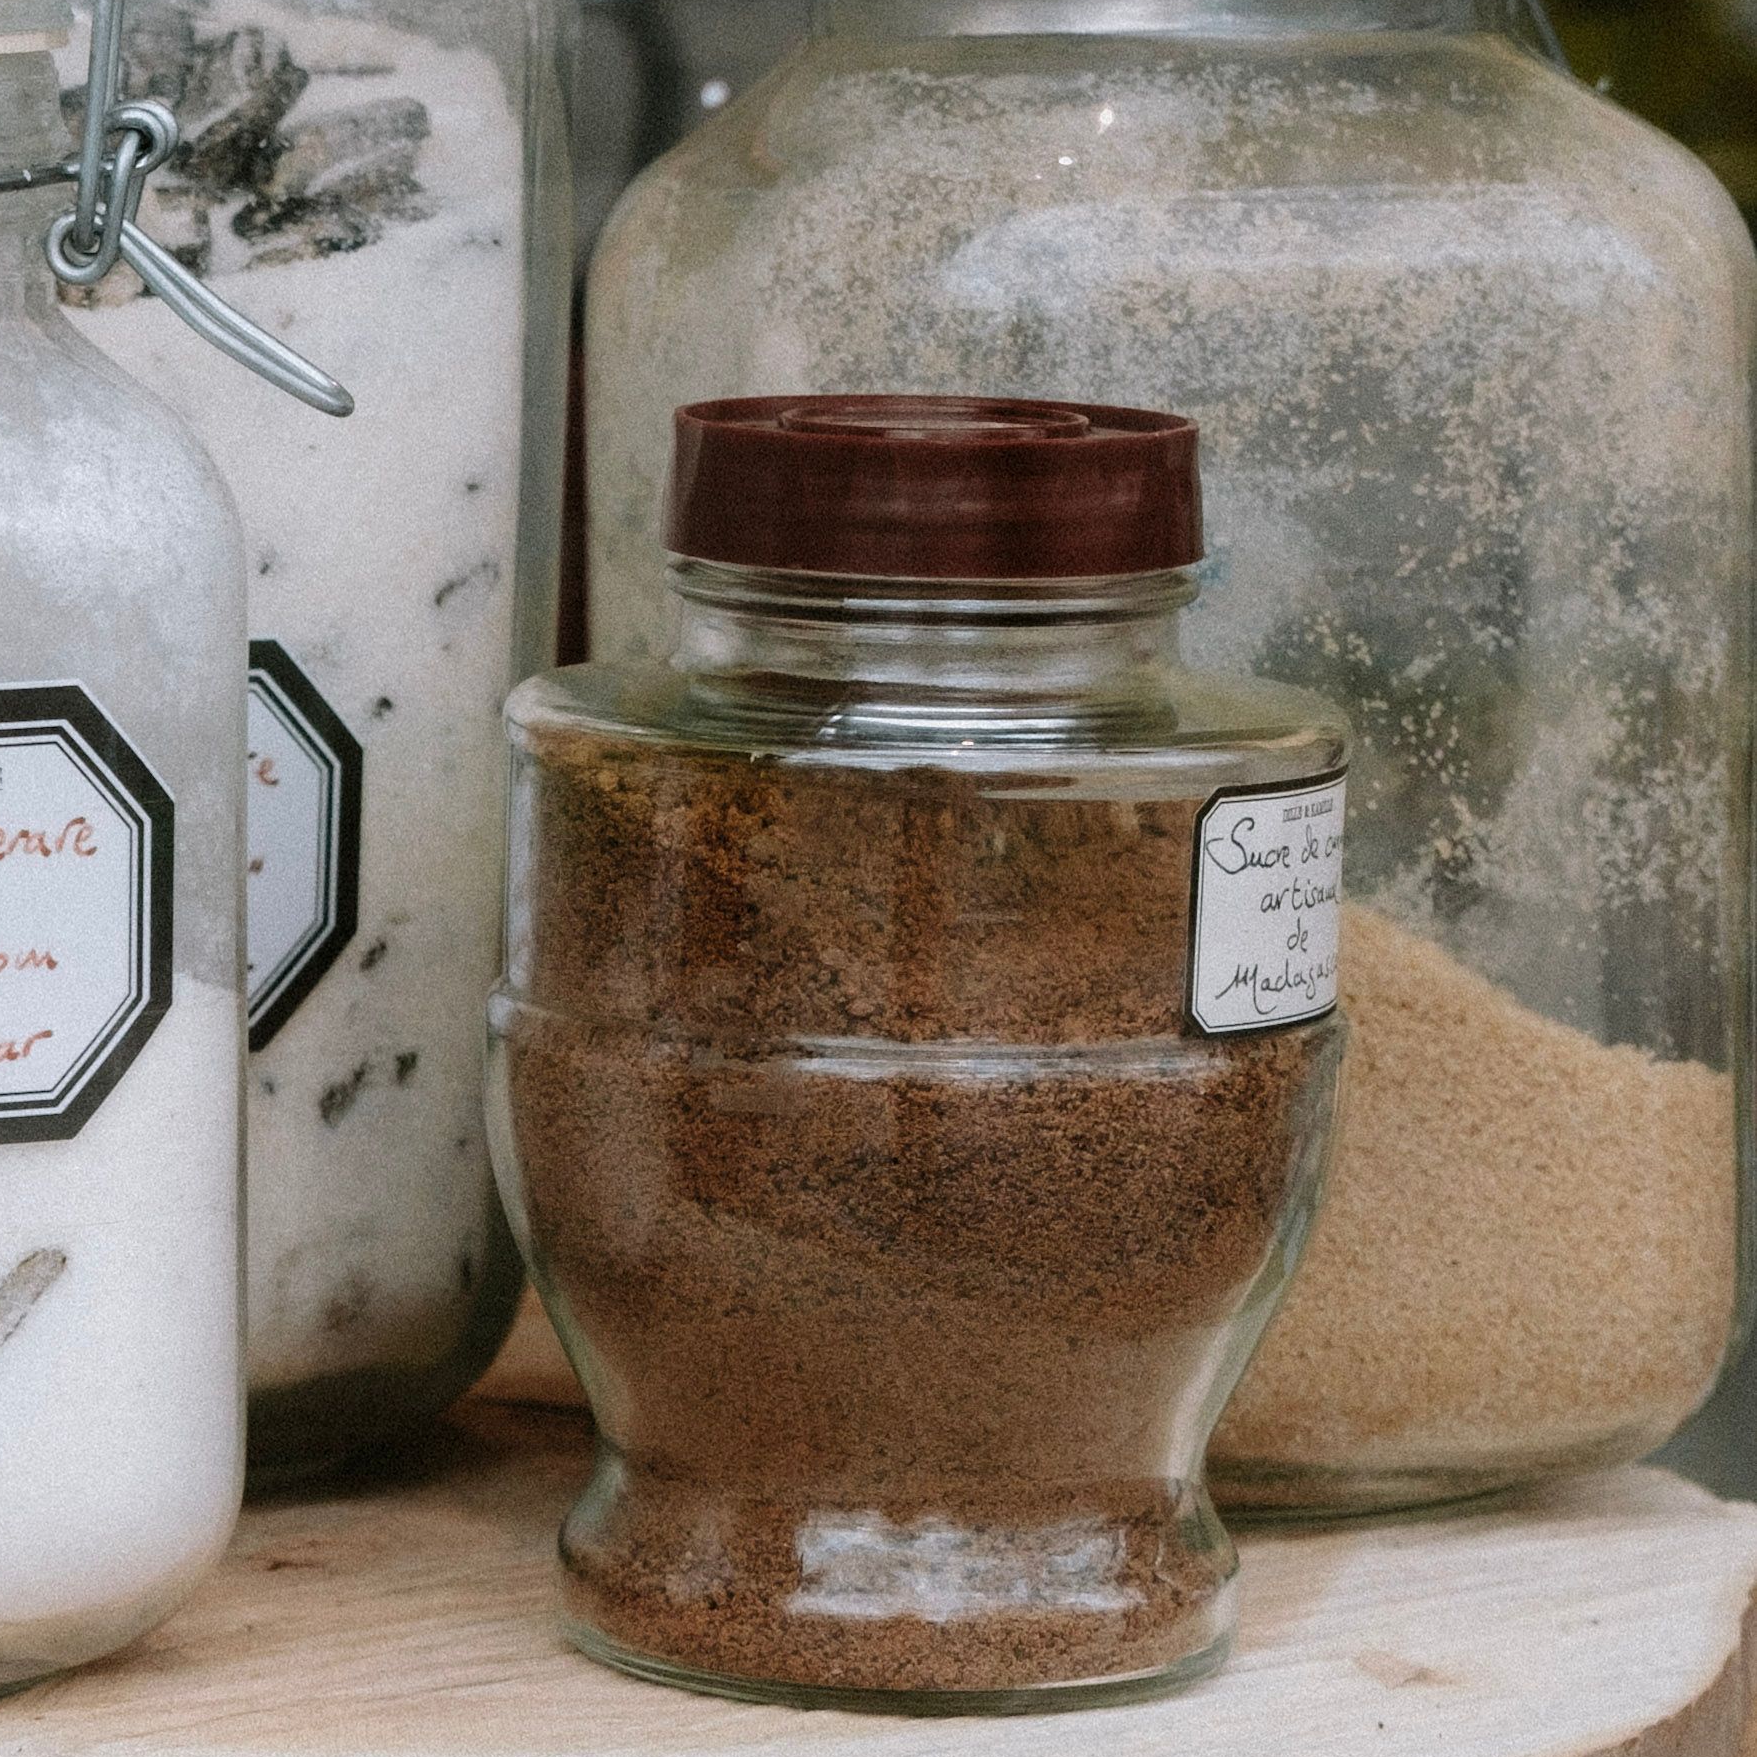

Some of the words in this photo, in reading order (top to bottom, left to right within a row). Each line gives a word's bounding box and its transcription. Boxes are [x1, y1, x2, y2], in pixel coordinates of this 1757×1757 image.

[1206, 816, 1291, 875] Sucre
[1301, 824, 1319, 864] de
[1286, 916, 1308, 953] de
